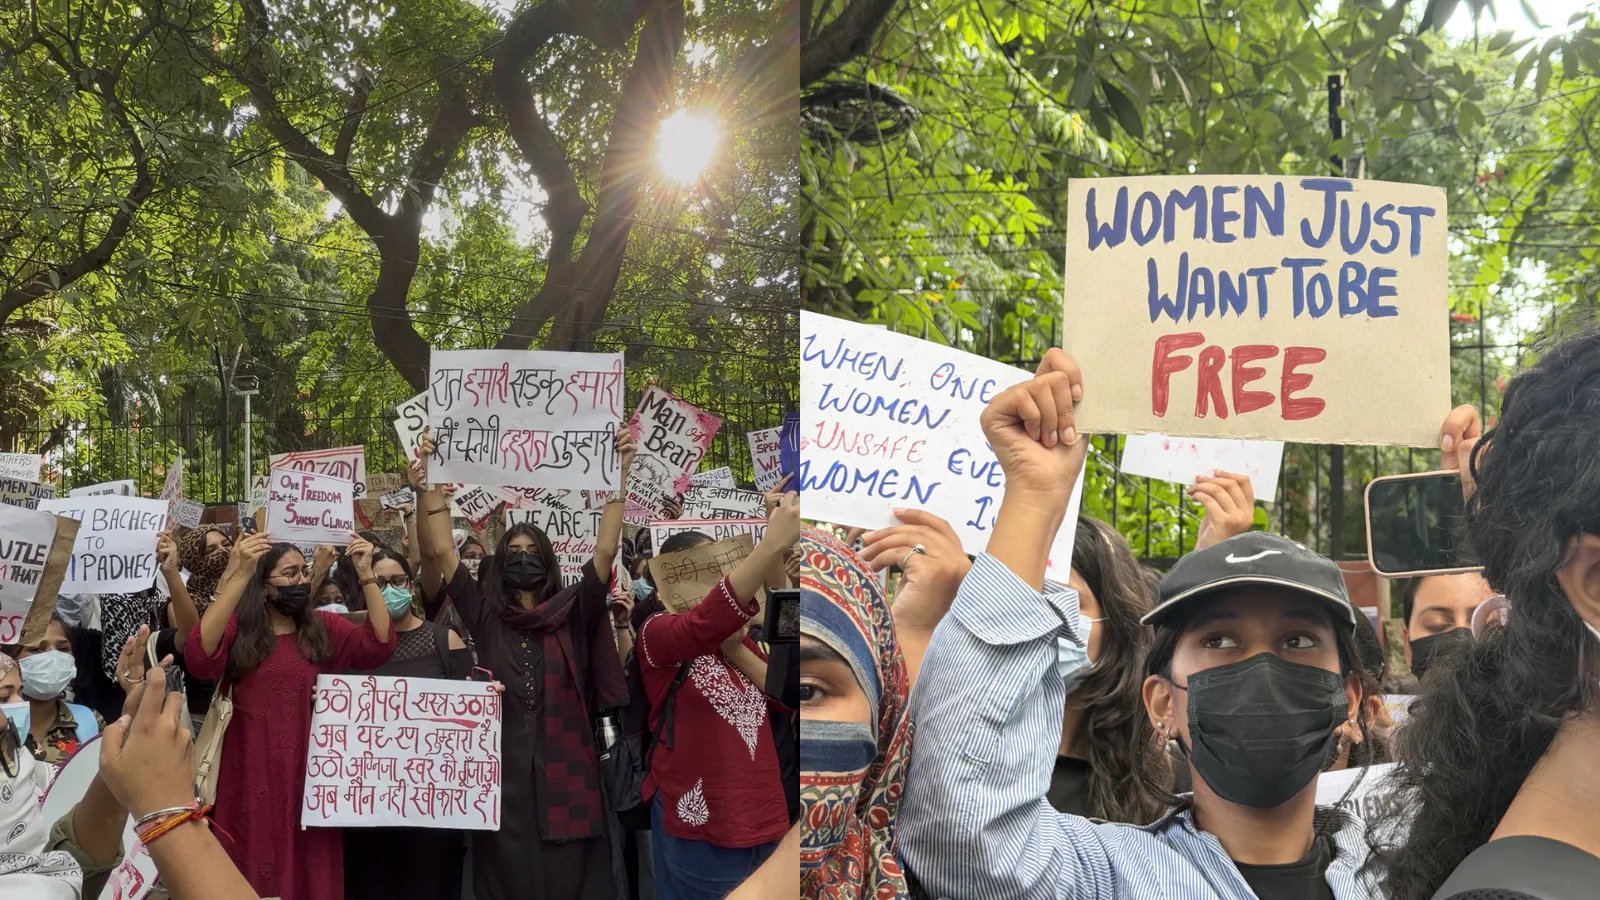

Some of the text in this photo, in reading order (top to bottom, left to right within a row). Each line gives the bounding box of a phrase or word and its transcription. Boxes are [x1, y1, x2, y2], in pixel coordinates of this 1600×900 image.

[1084, 178, 1437, 258] WOMEN JUST
[1146, 252, 1399, 324] WANT TO BE
[431, 358, 623, 419] रात हमारी सड़क हमारी
[802, 333, 996, 405] WHEN ONE
[1151, 331, 1328, 421] FREE
[640, 391, 708, 442] Man or
[817, 382, 952, 430] WOMEN
[453, 414, 500, 465] चलेगी
[500, 429, 553, 473] दहशत
[644, 425, 704, 473] Bear?
[753, 431, 769, 443] IF
[756, 442, 781, 454] SPEA
[814, 419, 927, 463] UNSAFE
[947, 447, 1006, 488] EVE
[0, 454, 32, 466] ATHERS
[0, 480, 54, 499] MEN JUST
[280, 475, 342, 503] OUR FREEDOM
[800, 459, 997, 531] WOMEN I
[92, 508, 165, 531] BACHEGI
[284, 503, 320, 526] SUNSET
[321, 509, 353, 530] CLAUSE
[545, 511, 584, 538] ARE
[84, 536, 104, 550] TO
[10, 565, 42, 585] THAT
[80, 553, 160, 581] PADHEGI
[314, 678, 352, 721] उठो
[312, 724, 348, 751] अब
[357, 725, 393, 751] यह
[394, 726, 420, 754] रण
[308, 749, 344, 779] उठो
[403, 758, 440, 784] स्वर
[439, 753, 458, 783] को
[305, 784, 339, 820] अब
[343, 776, 376, 816] मौन
